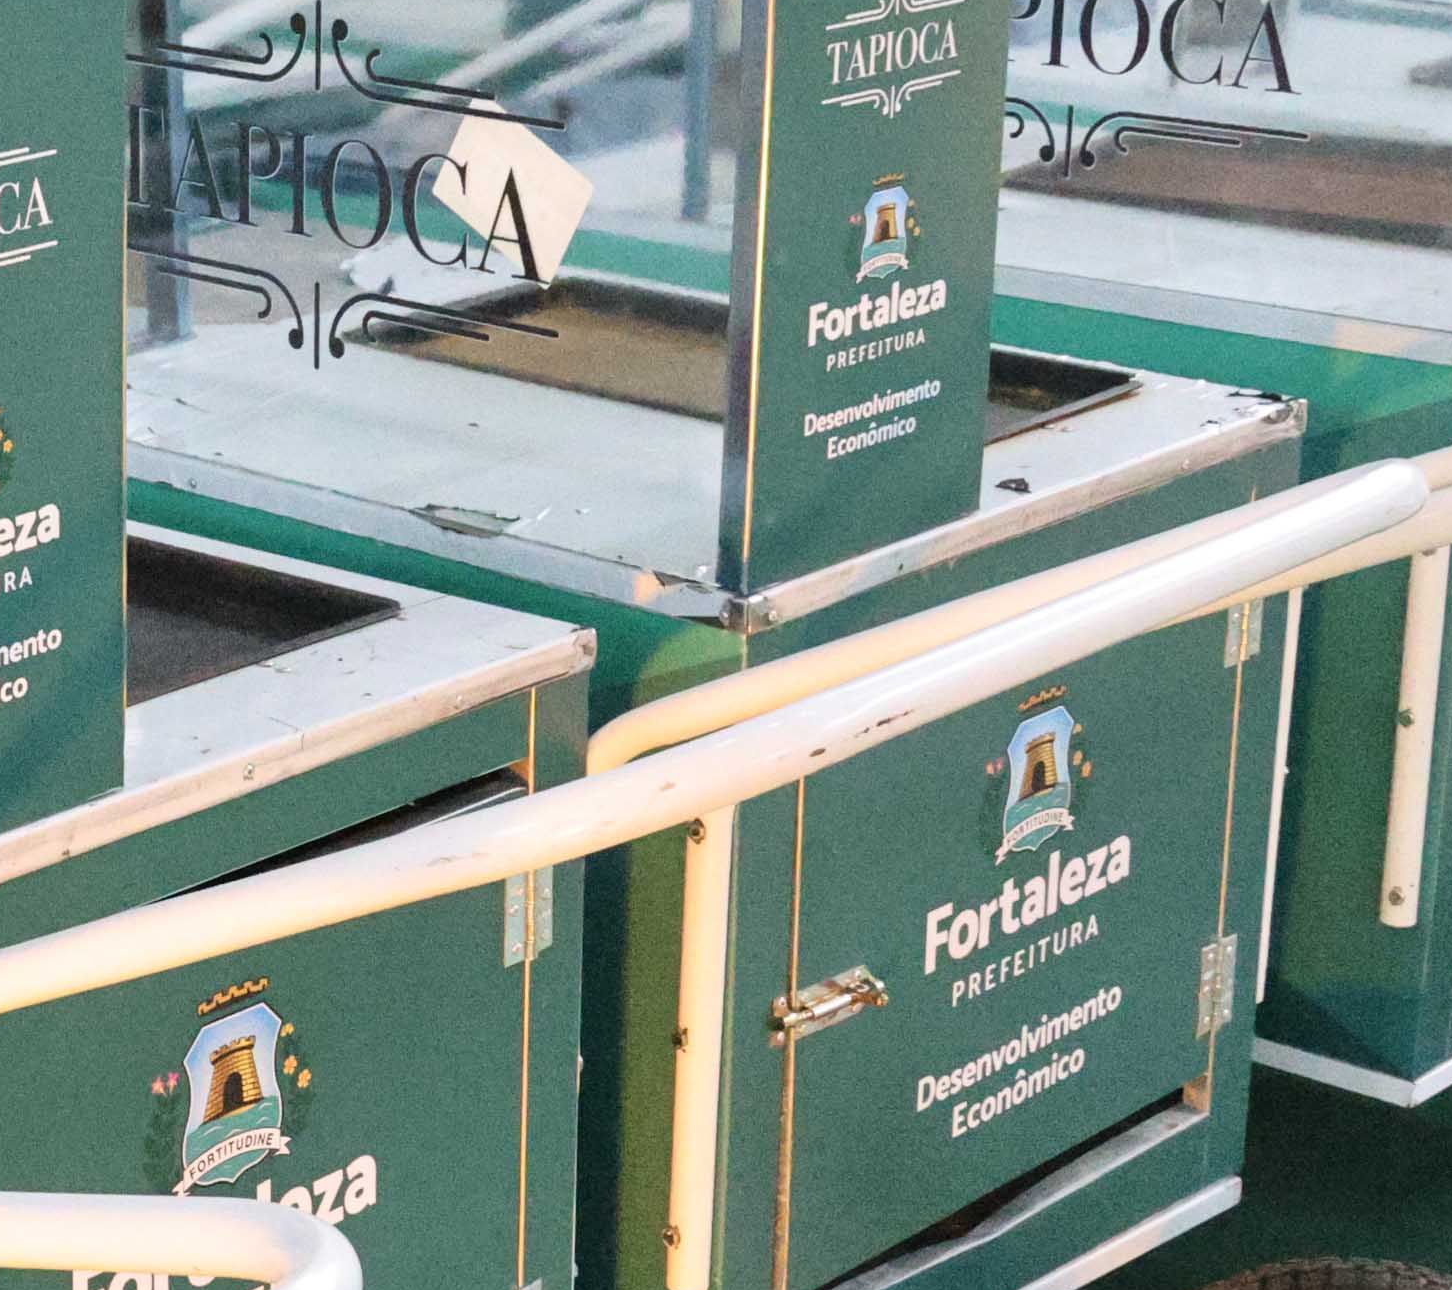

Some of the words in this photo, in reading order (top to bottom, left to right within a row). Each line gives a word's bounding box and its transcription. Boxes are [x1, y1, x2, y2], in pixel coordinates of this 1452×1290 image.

[827, 19, 959, 86] TAPIOCA
[127, 104, 551, 286] TAPIOCA
[807, 273, 948, 347] Fortaleza
[825, 328, 926, 372] PREFEITURA
[803, 376, 941, 438] Desenvolvimento
[825, 414, 917, 460] Econômico
[923, 834, 1132, 976] Fortaleza
[951, 913, 1100, 1008] PREFEITURA
[916, 984, 1123, 1113] Desenvolvimento
[950, 1047, 1085, 1138] Econômico
[189, 1131, 274, 1181] FORTITUDINE
